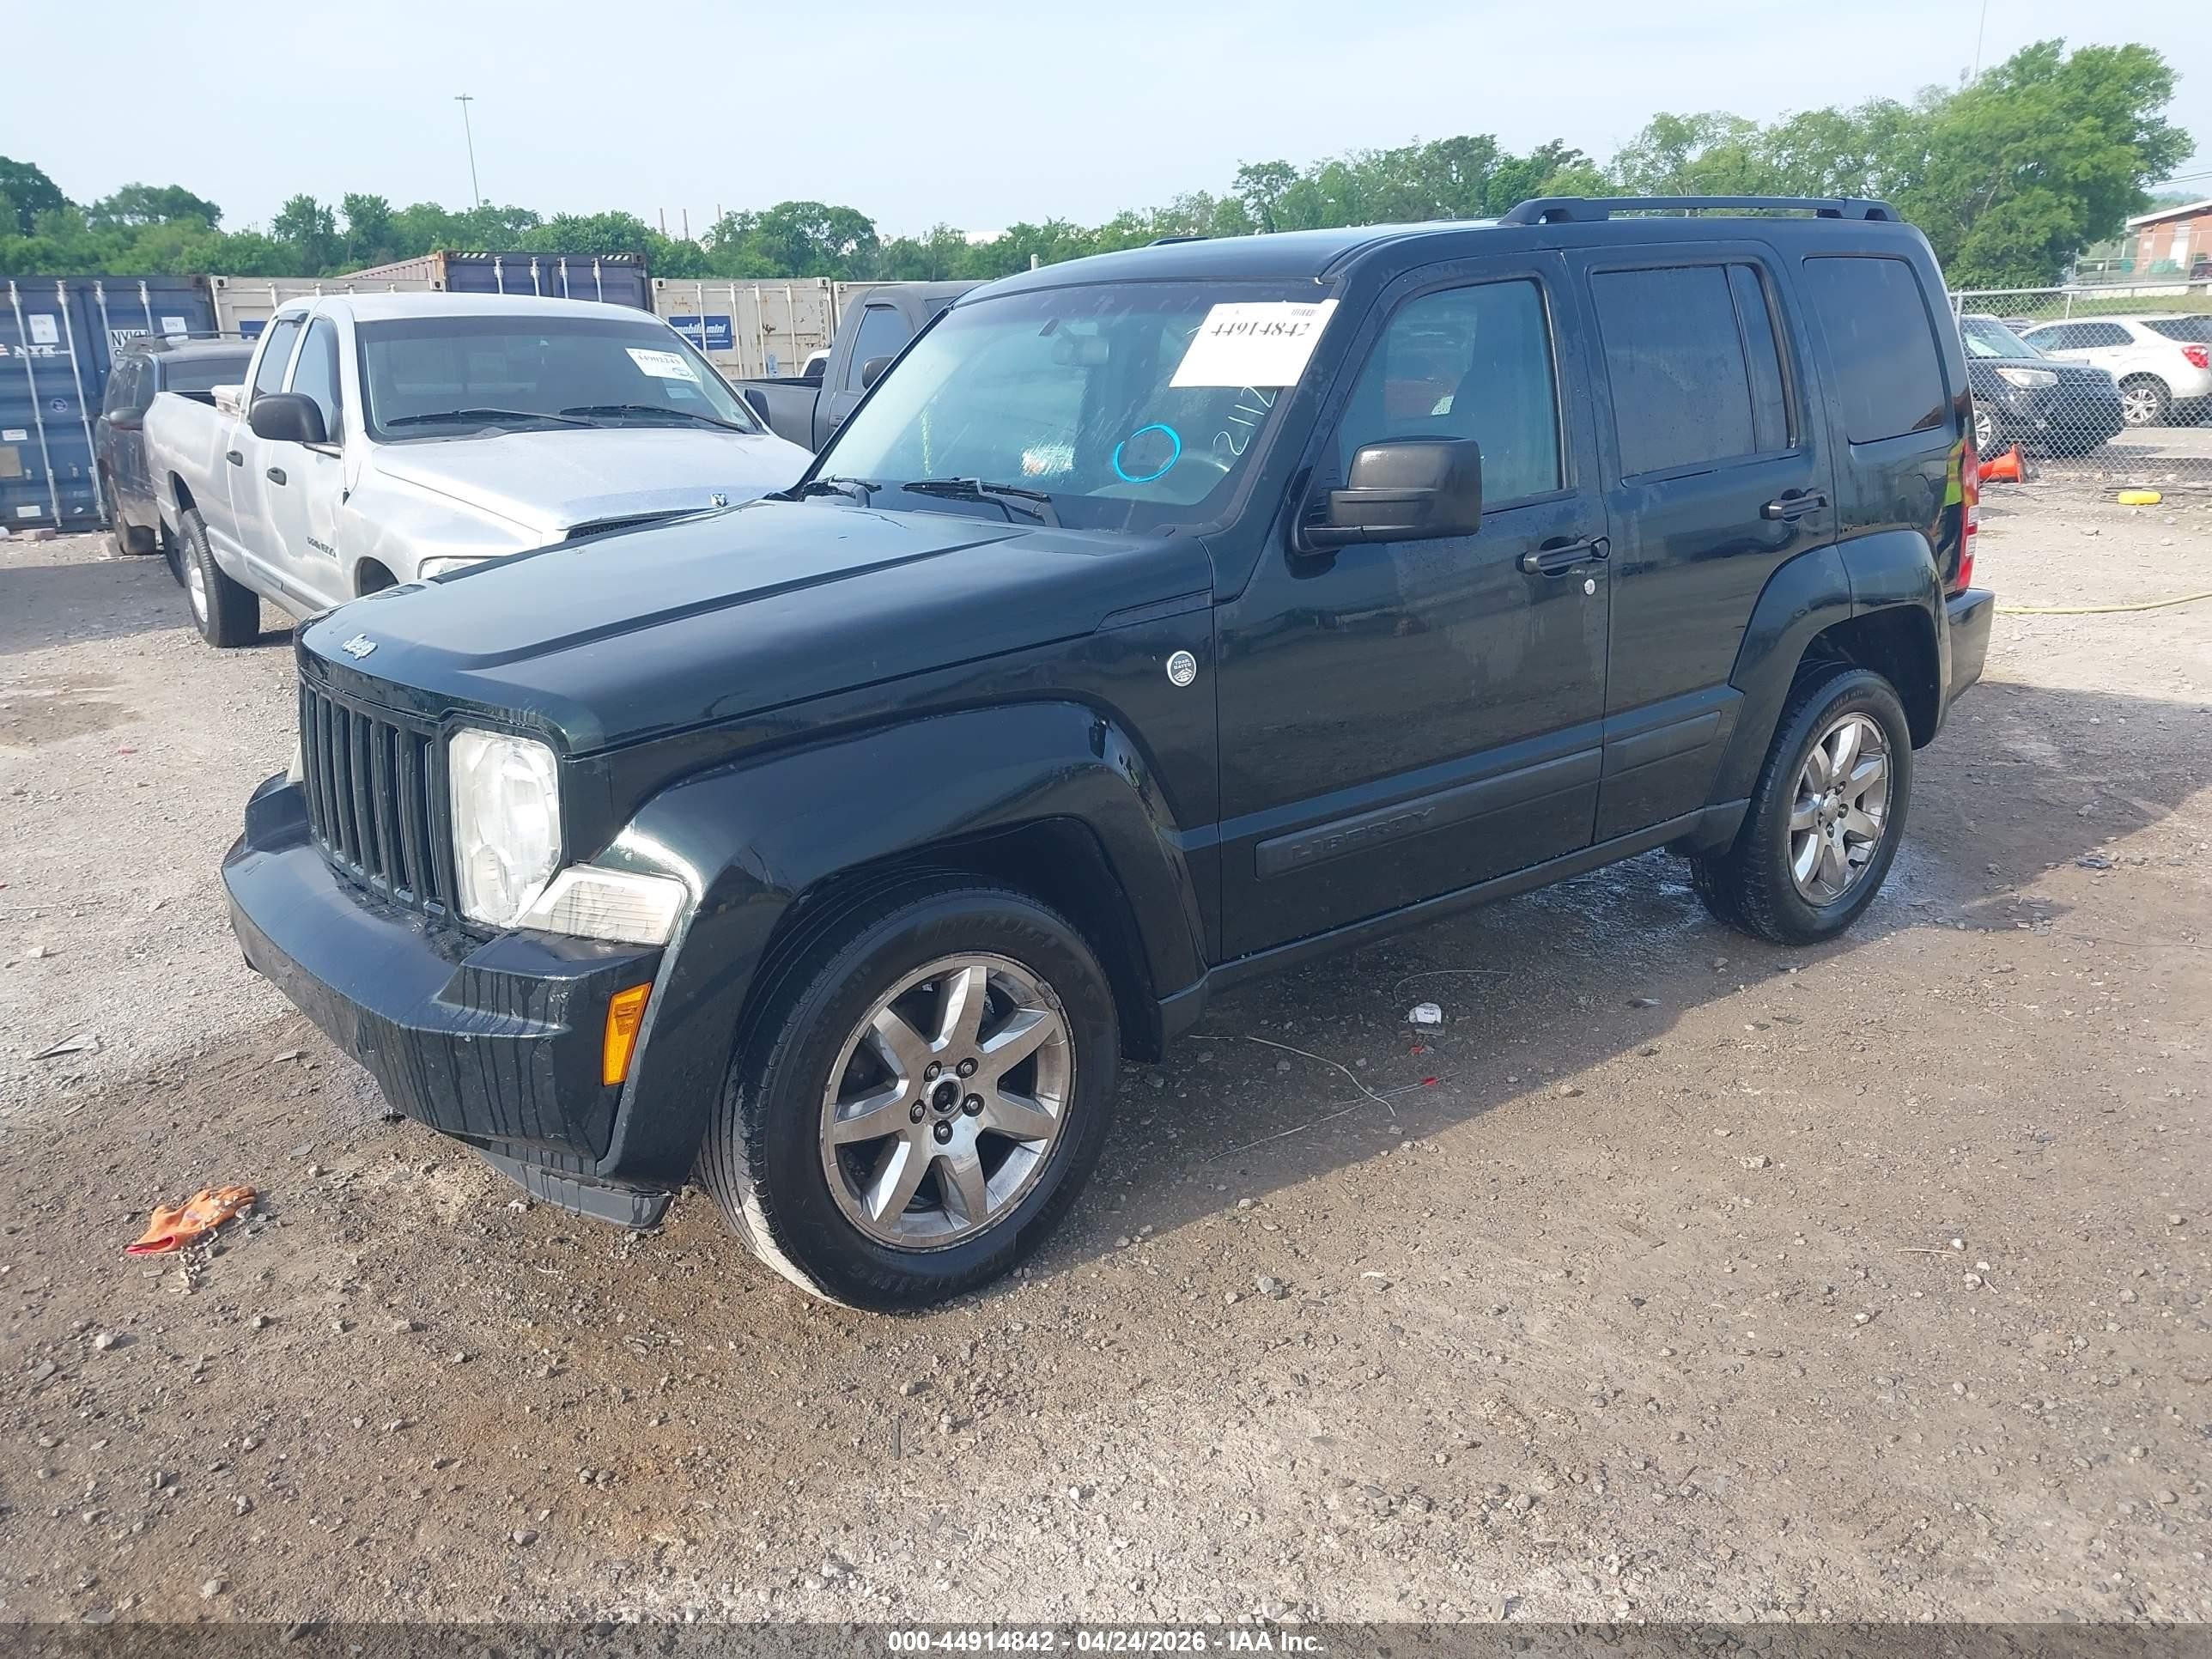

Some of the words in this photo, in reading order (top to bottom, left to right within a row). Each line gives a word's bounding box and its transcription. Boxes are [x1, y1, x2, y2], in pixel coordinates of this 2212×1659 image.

[706, 324, 727, 334] mini
[1211, 321, 1310, 337] 44914842
[14, 345, 56, 358] NYK
[1213, 386, 1277, 455] 2112
[342, 633, 378, 660] Jeep
[1291, 807, 1437, 859] LIBERTY
